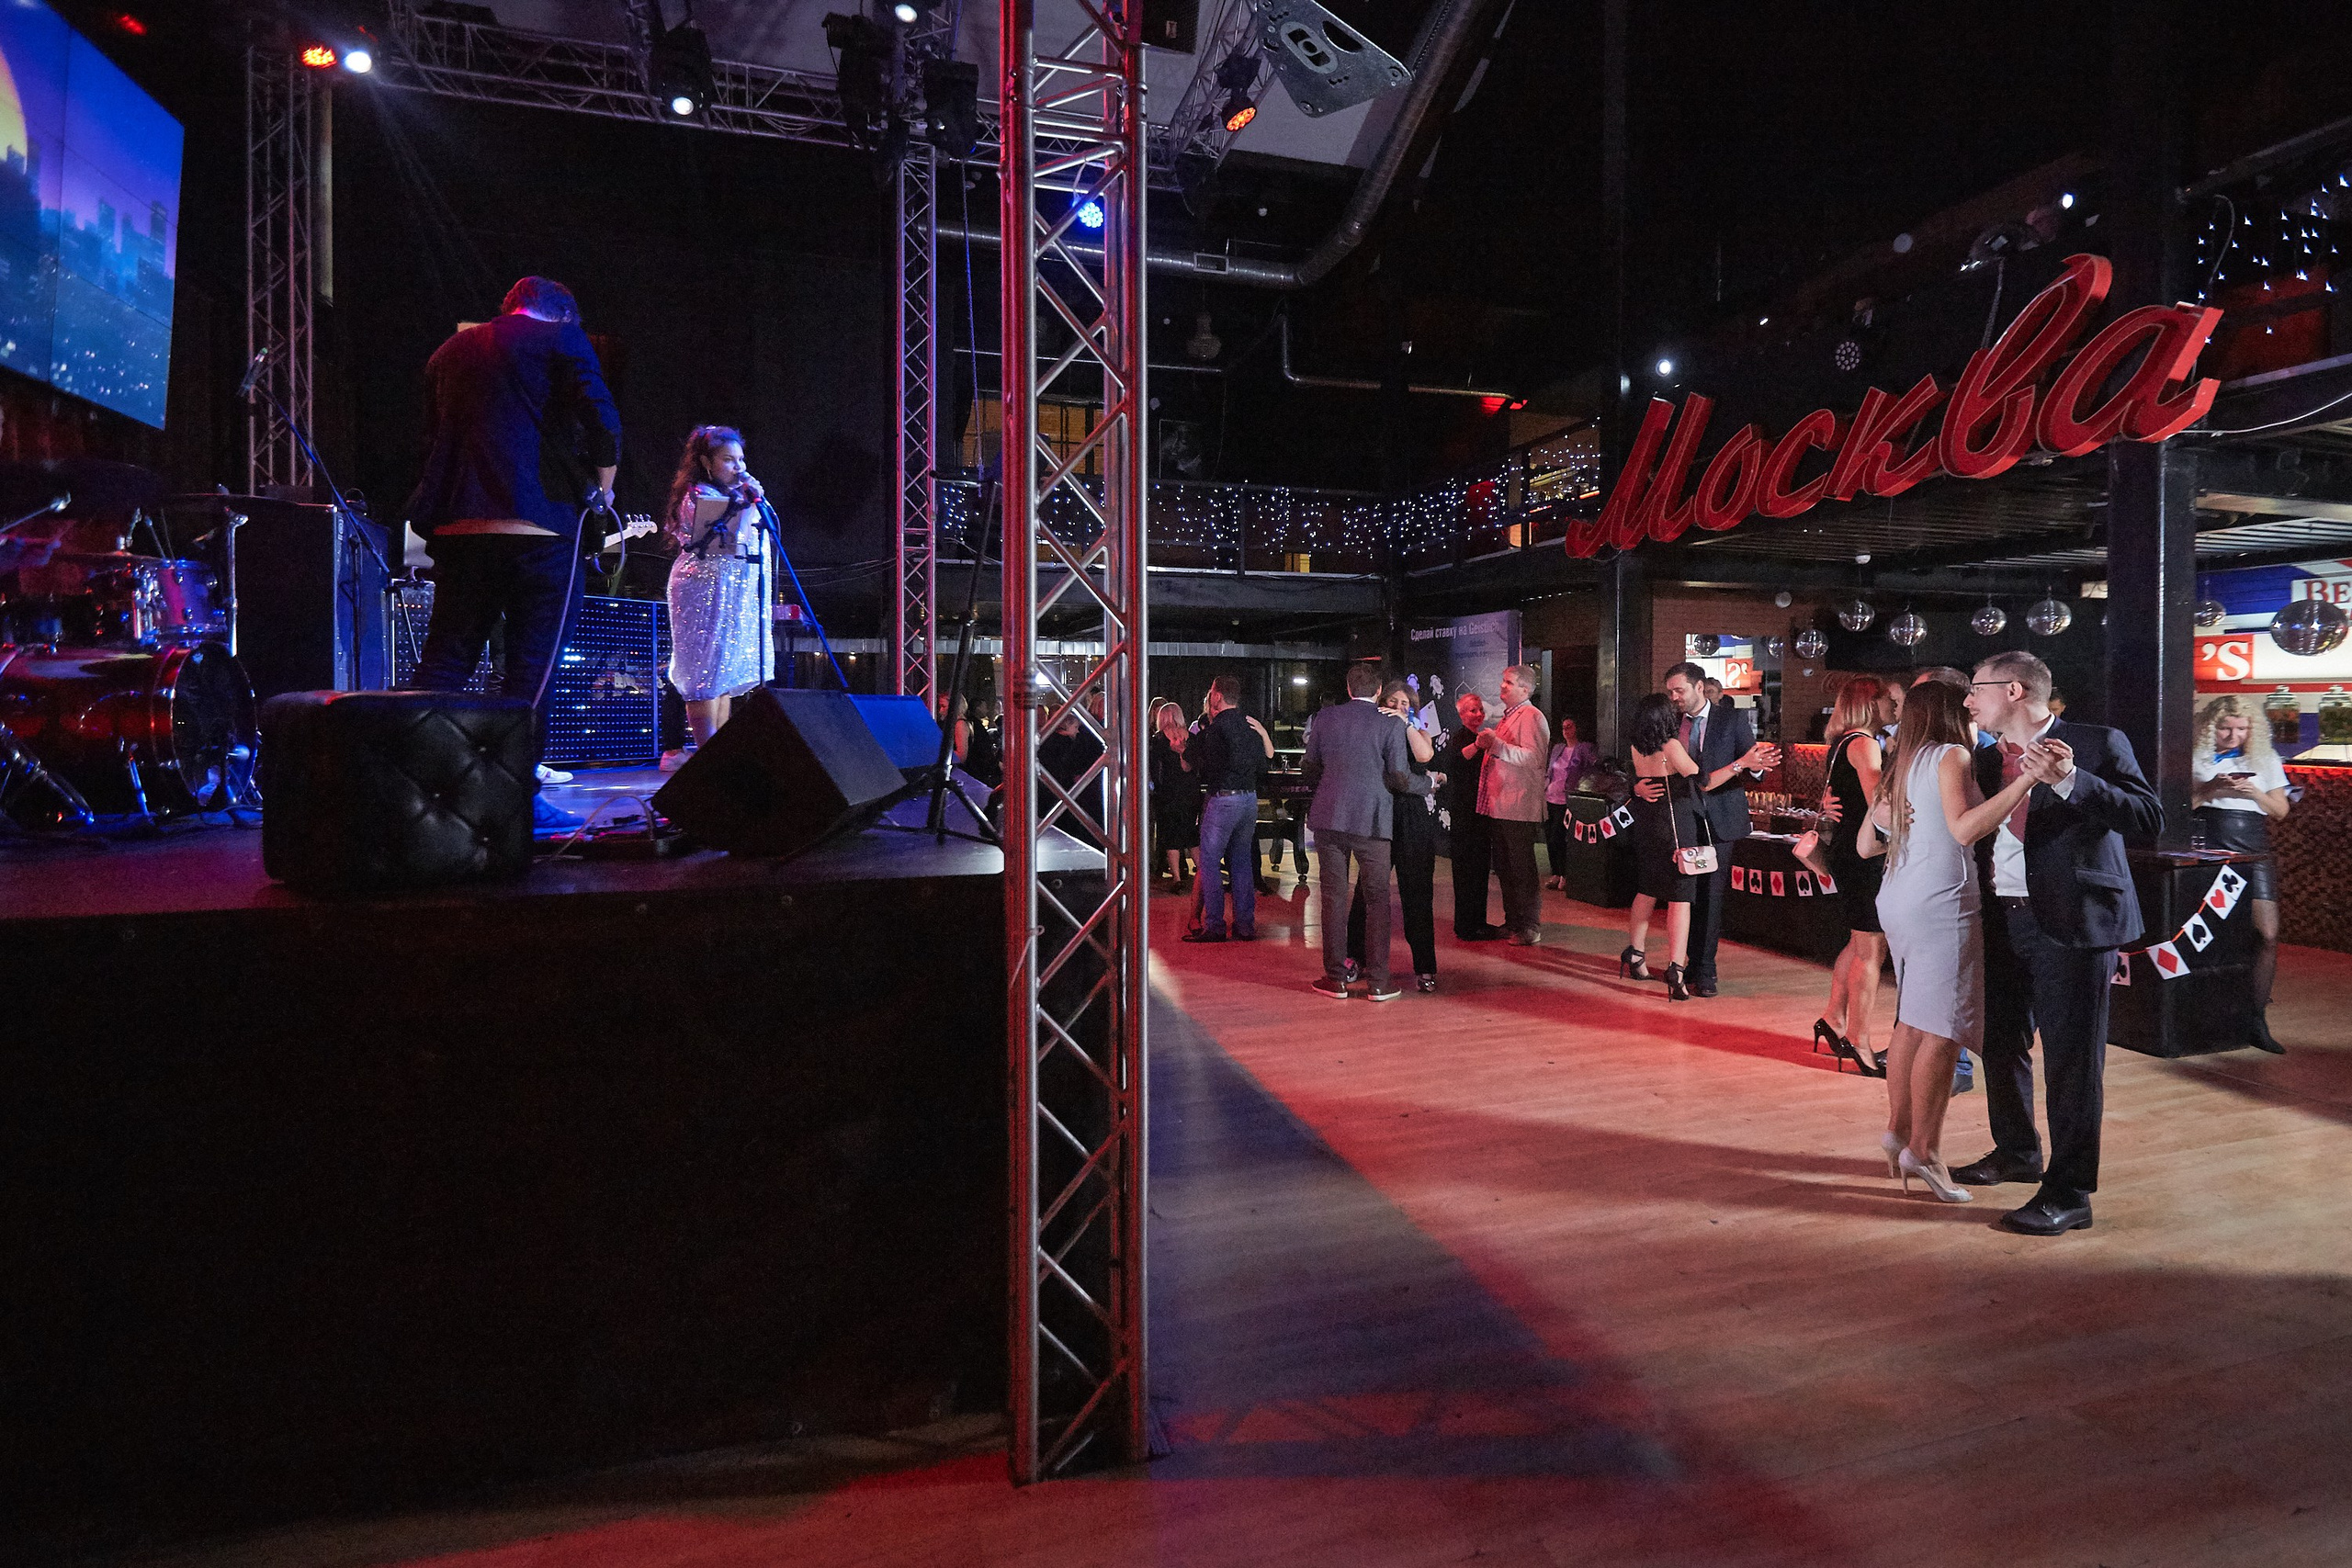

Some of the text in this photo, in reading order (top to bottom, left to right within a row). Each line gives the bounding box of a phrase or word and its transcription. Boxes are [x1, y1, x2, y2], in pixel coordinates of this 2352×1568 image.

[1566, 253, 2224, 559] Москва
[1410, 626, 1434, 642] Сделай
[1435, 626, 1457, 639] ставку
[1458, 626, 1467, 636] на
